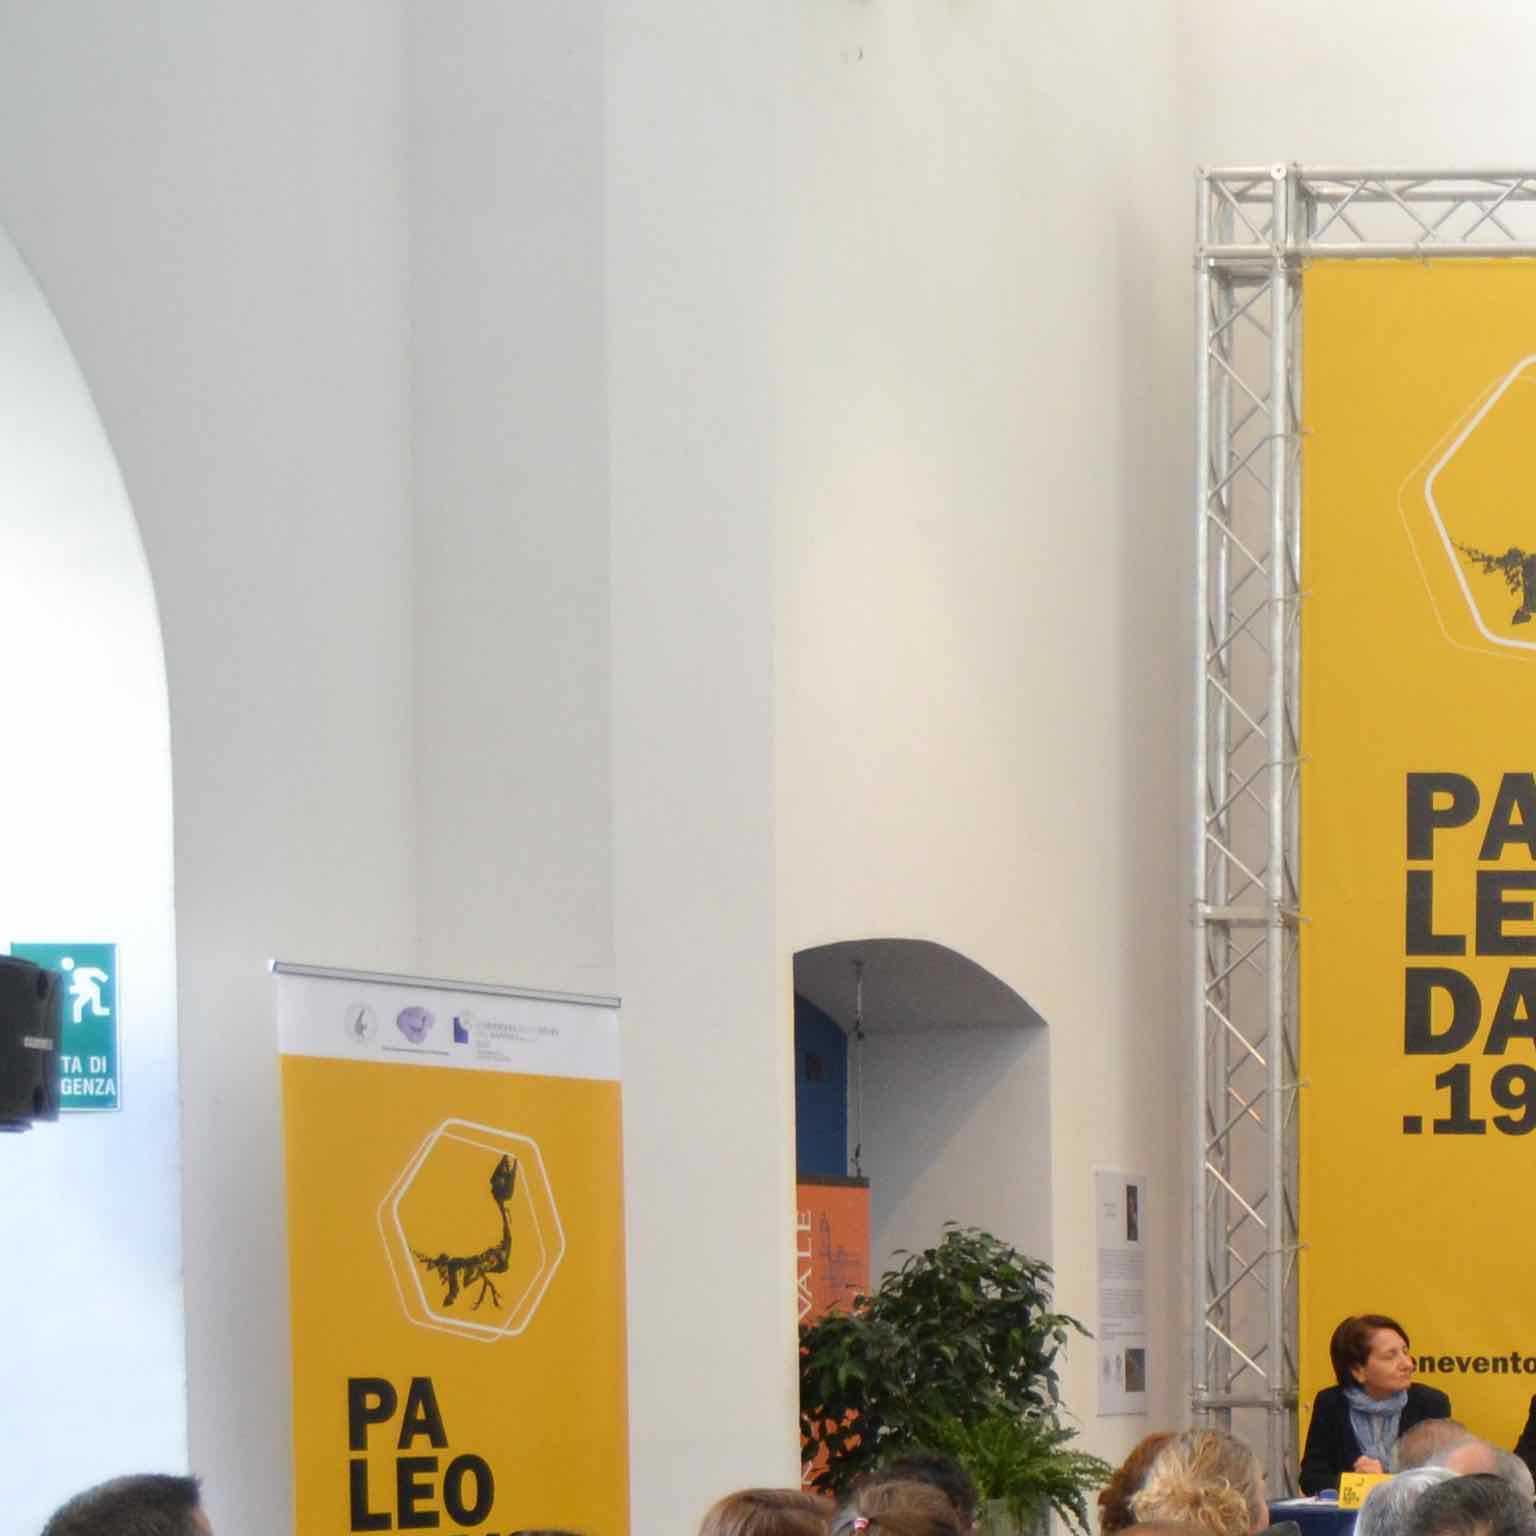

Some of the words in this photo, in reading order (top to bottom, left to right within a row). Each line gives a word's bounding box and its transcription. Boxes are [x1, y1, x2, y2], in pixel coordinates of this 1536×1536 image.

[60, 1079, 116, 1096] GENZA
[91, 1056, 107, 1073] DI
[797, 1209, 813, 1321] VALE
[347, 1377, 449, 1451] PA
[350, 1454, 495, 1532] LEO
